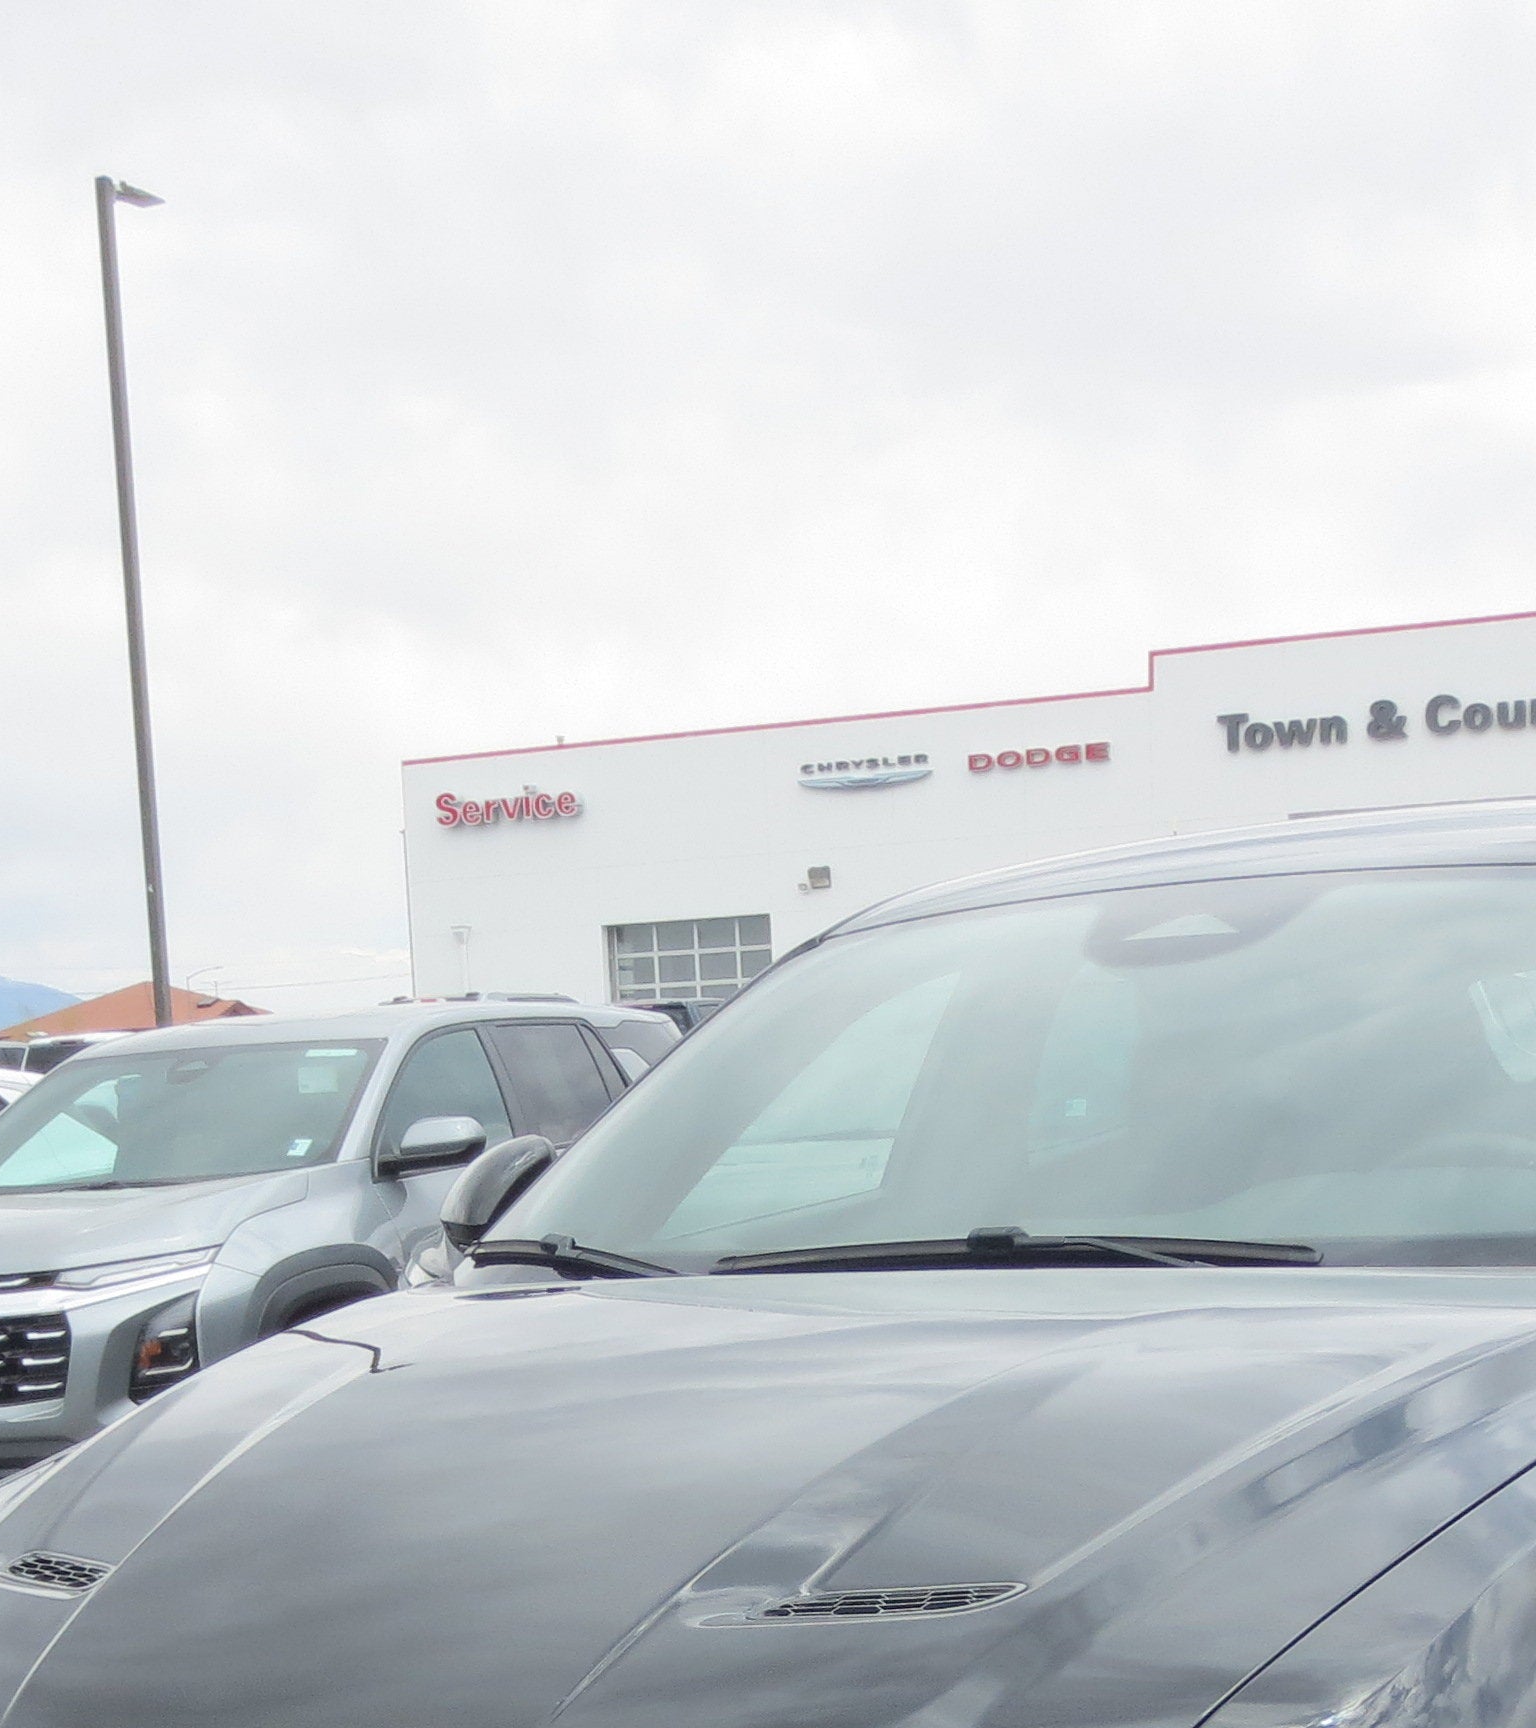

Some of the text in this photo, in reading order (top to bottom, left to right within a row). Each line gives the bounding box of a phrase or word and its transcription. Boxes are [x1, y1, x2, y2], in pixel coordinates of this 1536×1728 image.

[1216, 711, 1348, 753] Town
[1365, 698, 1408, 742] &
[800, 753, 930, 775] CHRYSLER
[967, 741, 1111, 773] DODGE
[435, 784, 578, 828] Service
